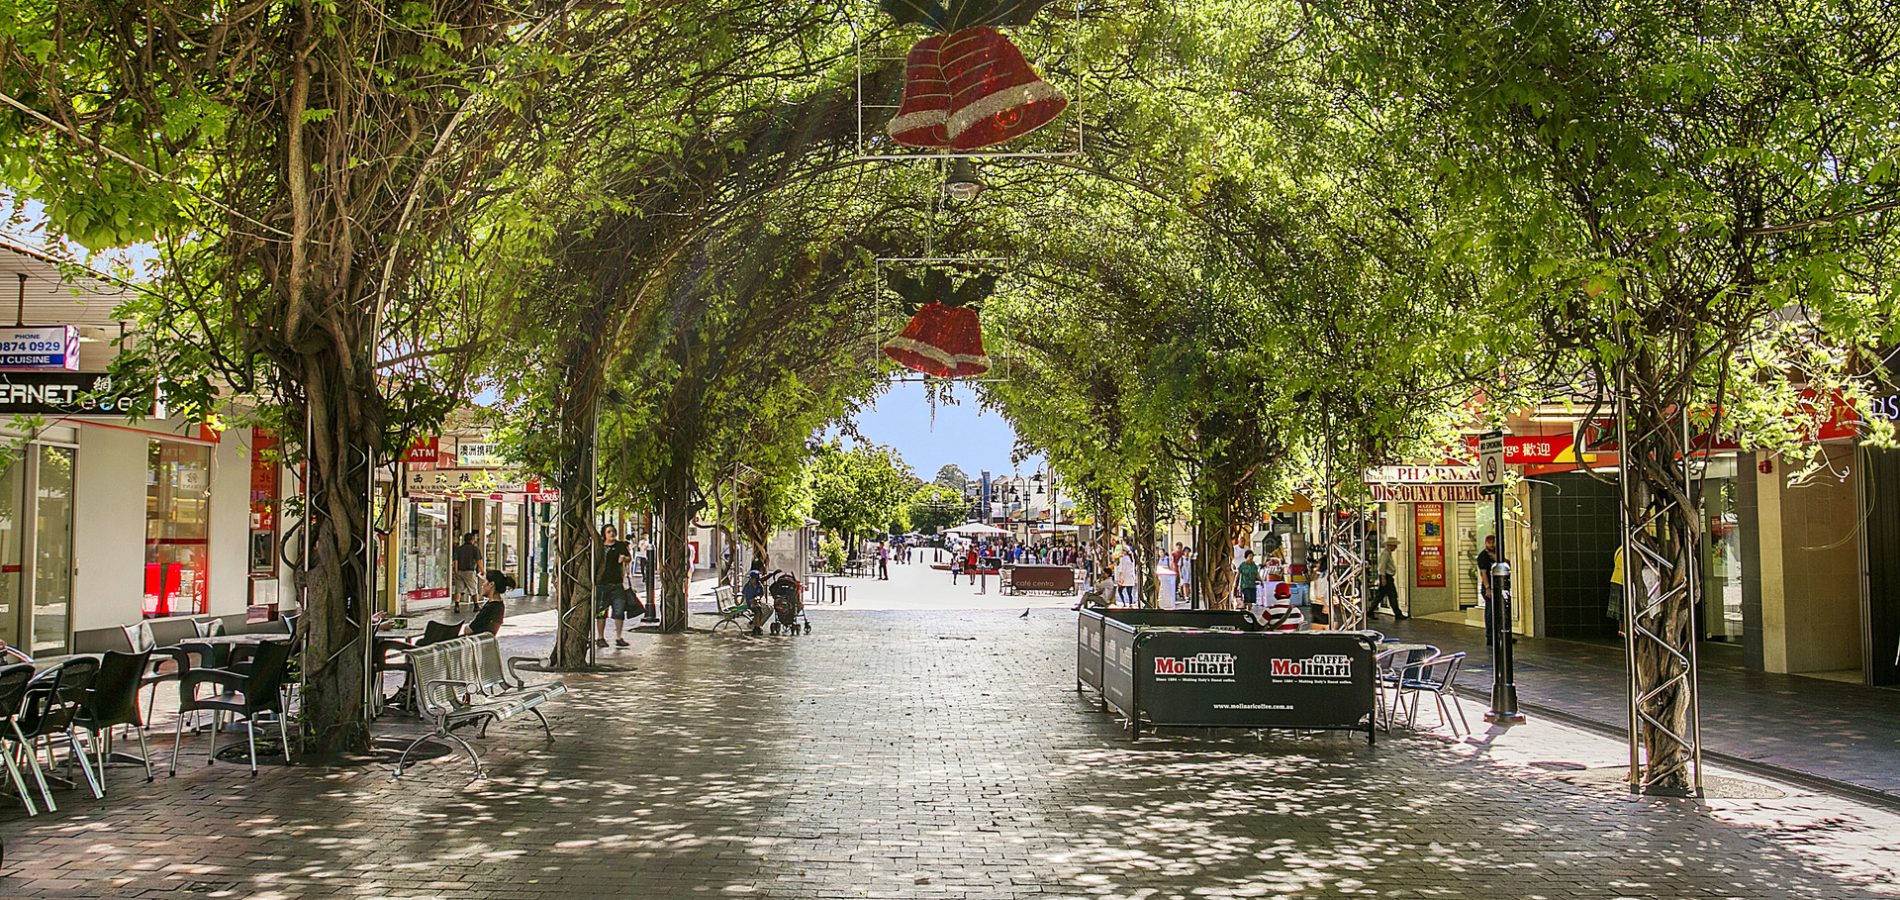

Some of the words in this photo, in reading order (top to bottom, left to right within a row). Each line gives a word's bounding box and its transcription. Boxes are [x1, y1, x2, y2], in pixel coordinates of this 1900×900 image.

[29, 341, 60, 351] 0929
[6, 355, 50, 364] CUISINE
[410, 448, 435, 457] ATM
[1522, 443, 1551, 457] 歡迎
[1373, 486, 1436, 501] DISCOUNT
[1016, 579, 1031, 587] café
[1156, 657, 1234, 674] Molinari
[1272, 659, 1350, 676] Molinari
